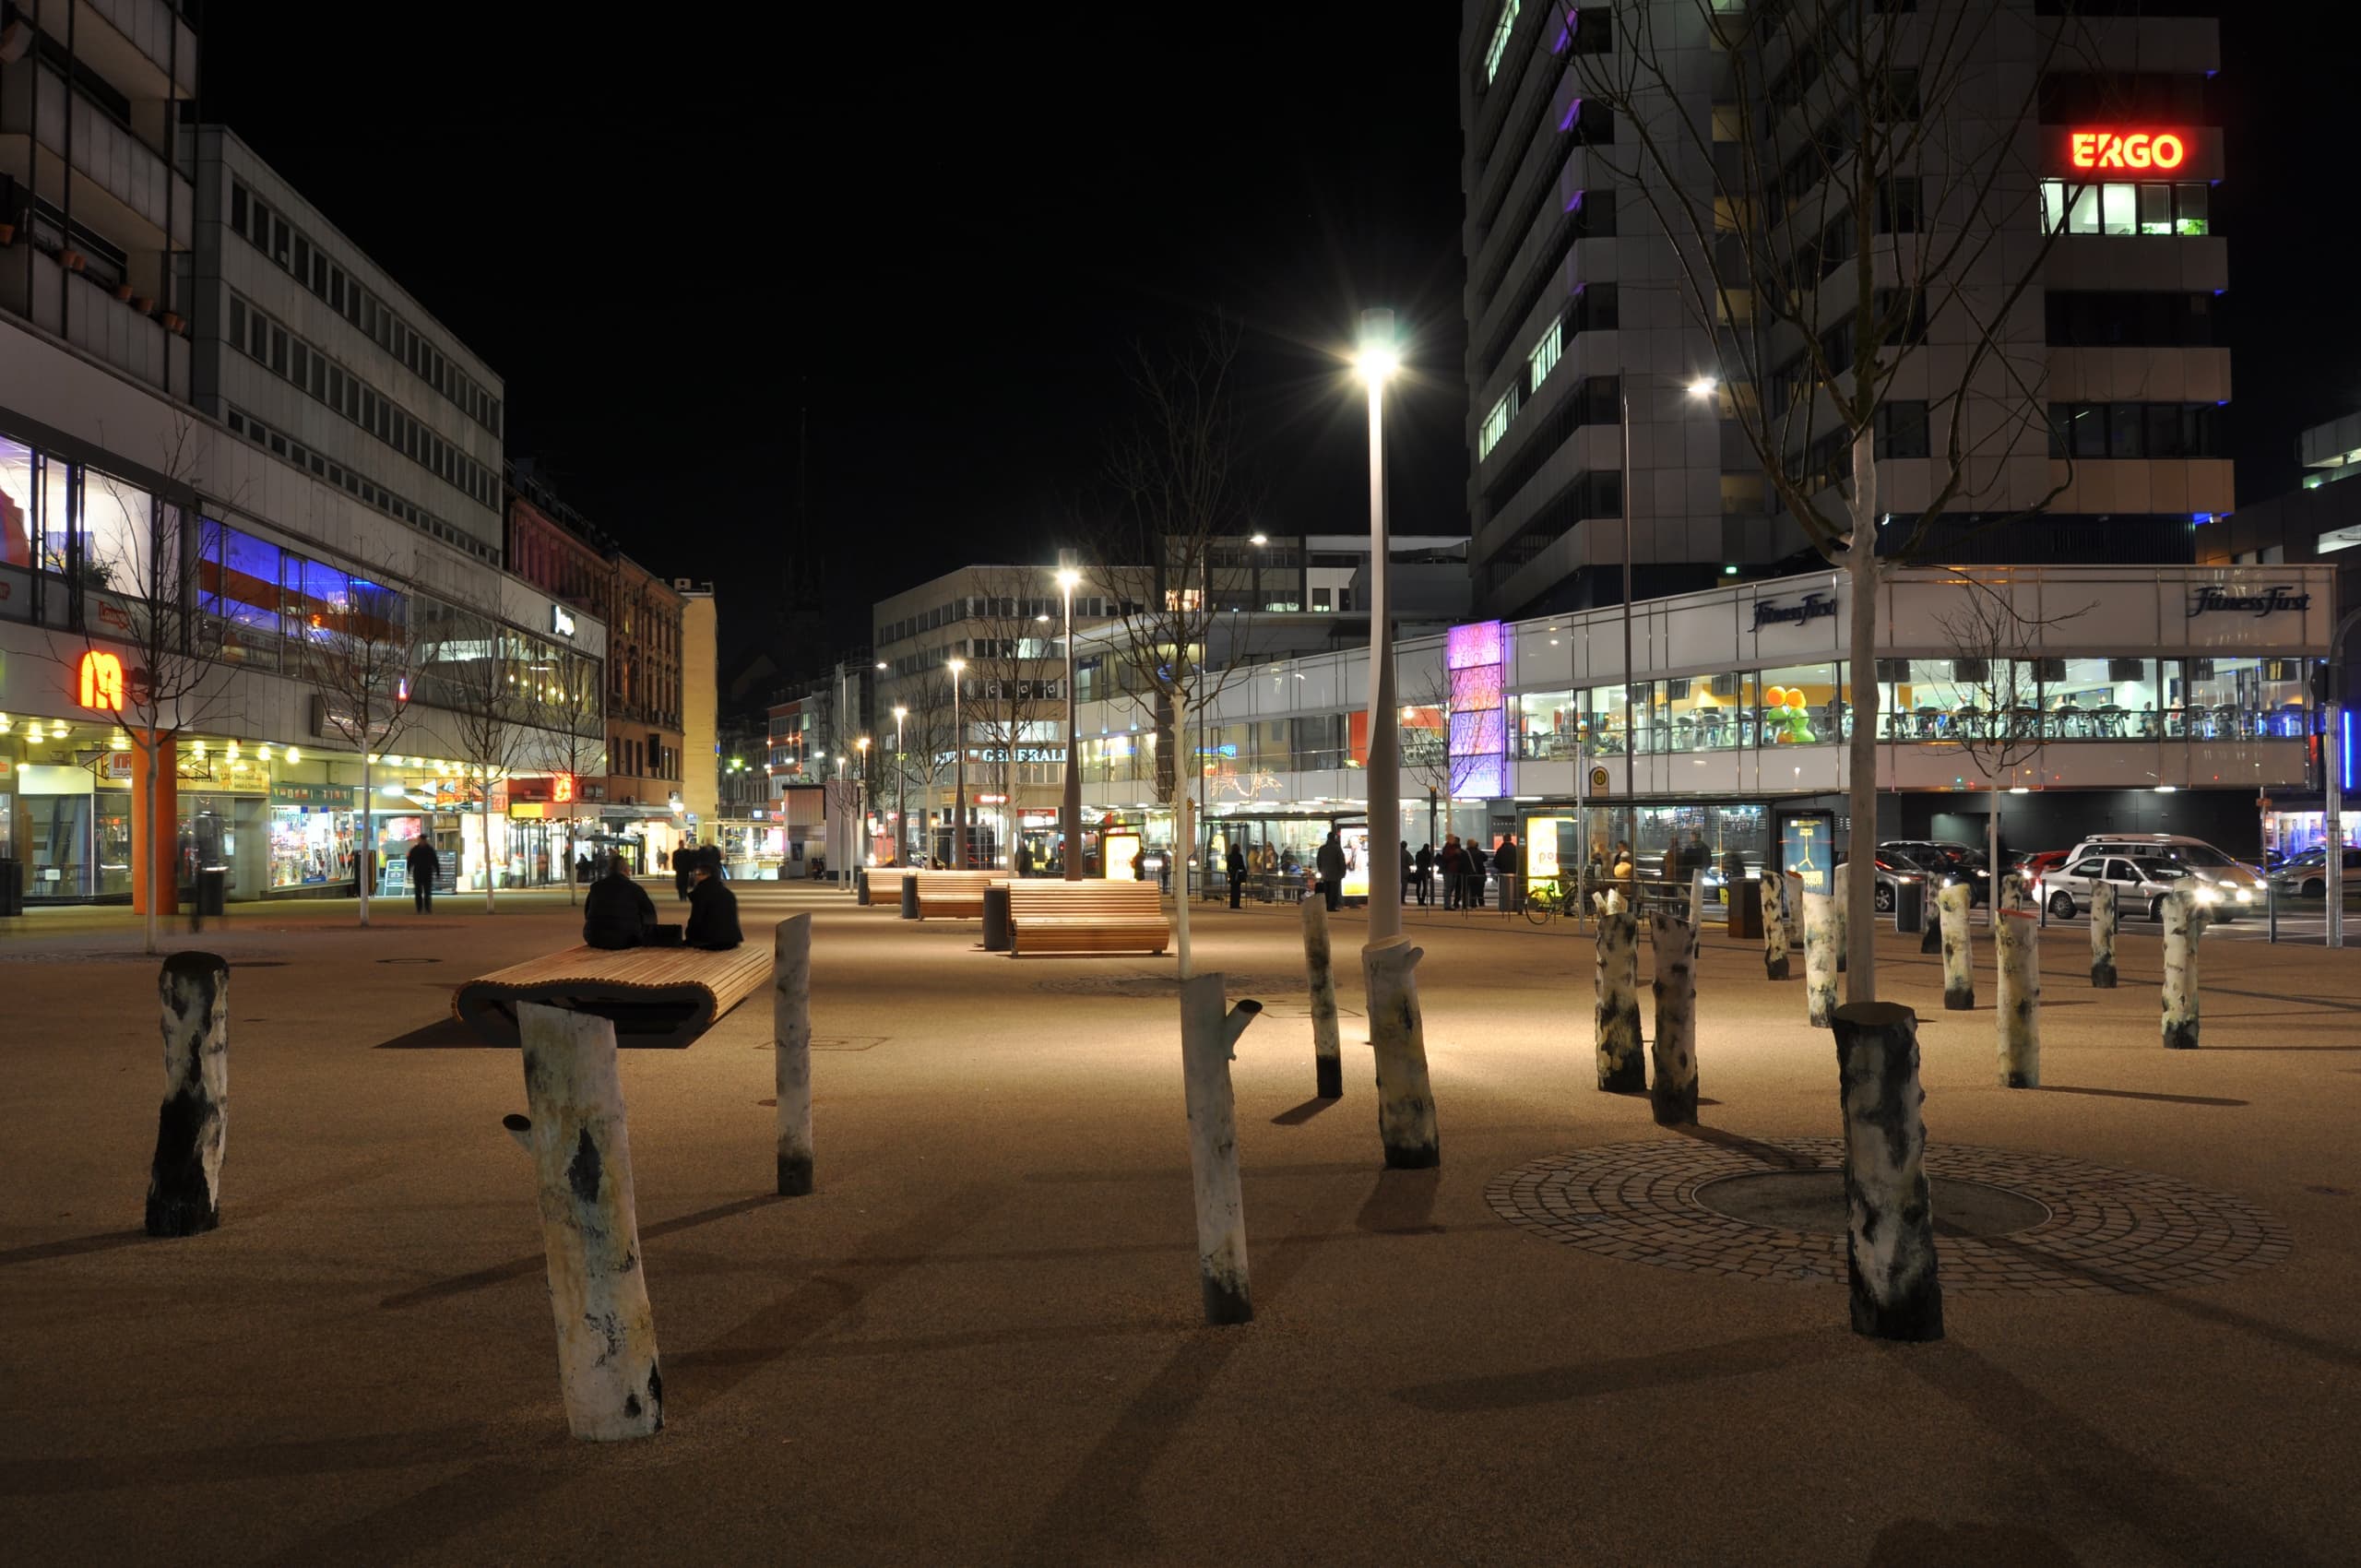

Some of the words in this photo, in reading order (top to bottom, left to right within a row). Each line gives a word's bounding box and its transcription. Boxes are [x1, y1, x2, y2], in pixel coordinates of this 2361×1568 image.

[2072, 133, 2184, 169] ERGO
[2186, 587, 2265, 617] Fitness
[2254, 587, 2311, 617] First
